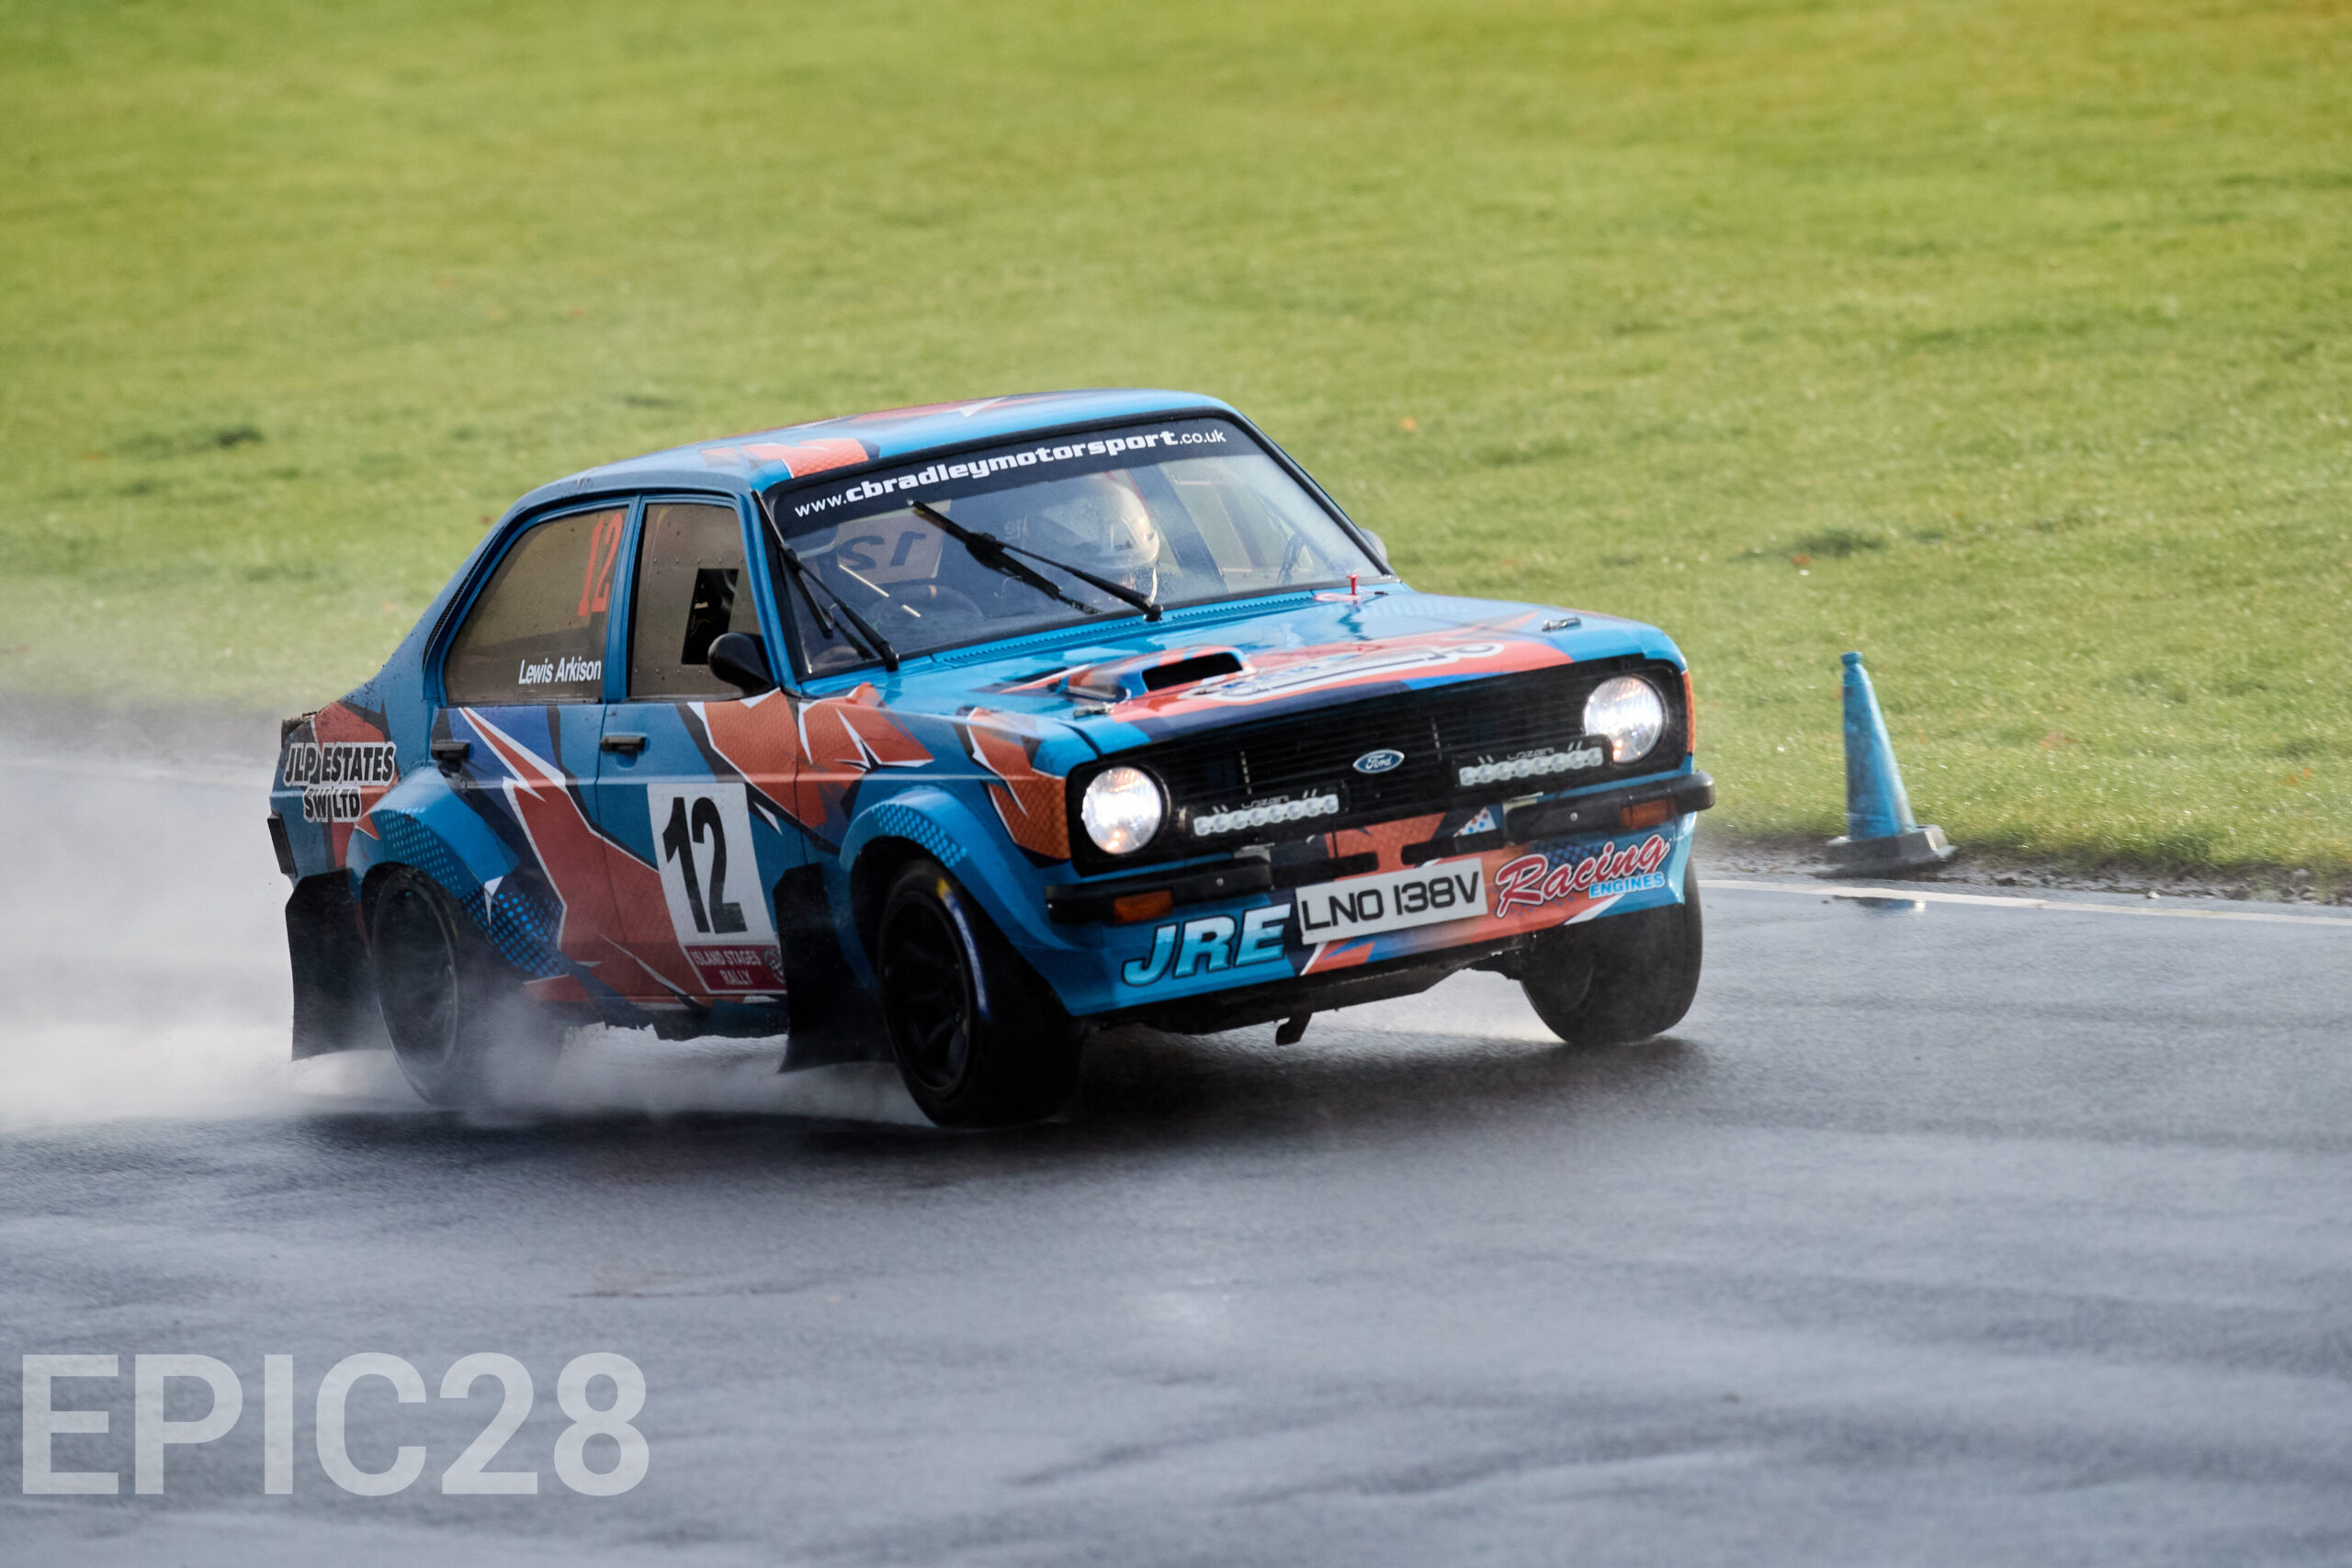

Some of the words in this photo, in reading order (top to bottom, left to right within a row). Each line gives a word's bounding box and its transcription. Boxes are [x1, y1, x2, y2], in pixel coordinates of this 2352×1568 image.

[795, 429, 1227, 517] www.cbradleymotorsport.co.uk
[577, 513, 623, 616] 12
[518, 658, 553, 684] Lewis
[555, 656, 602, 682] Arkison
[283, 742, 318, 786] JLP
[320, 741, 397, 786] ESTATES
[331, 787, 362, 823] LTD
[662, 796, 748, 934] 12
[1496, 834, 1670, 918] Racing
[1589, 872, 1666, 898] ENGINES
[1301, 888, 1384, 931] LNO
[1394, 871, 1479, 915] 138V
[690, 951, 727, 966] ISLAND
[722, 950, 762, 966] STAGES
[1122, 903, 1291, 987] JRE
[718, 969, 753, 986] RALLY
